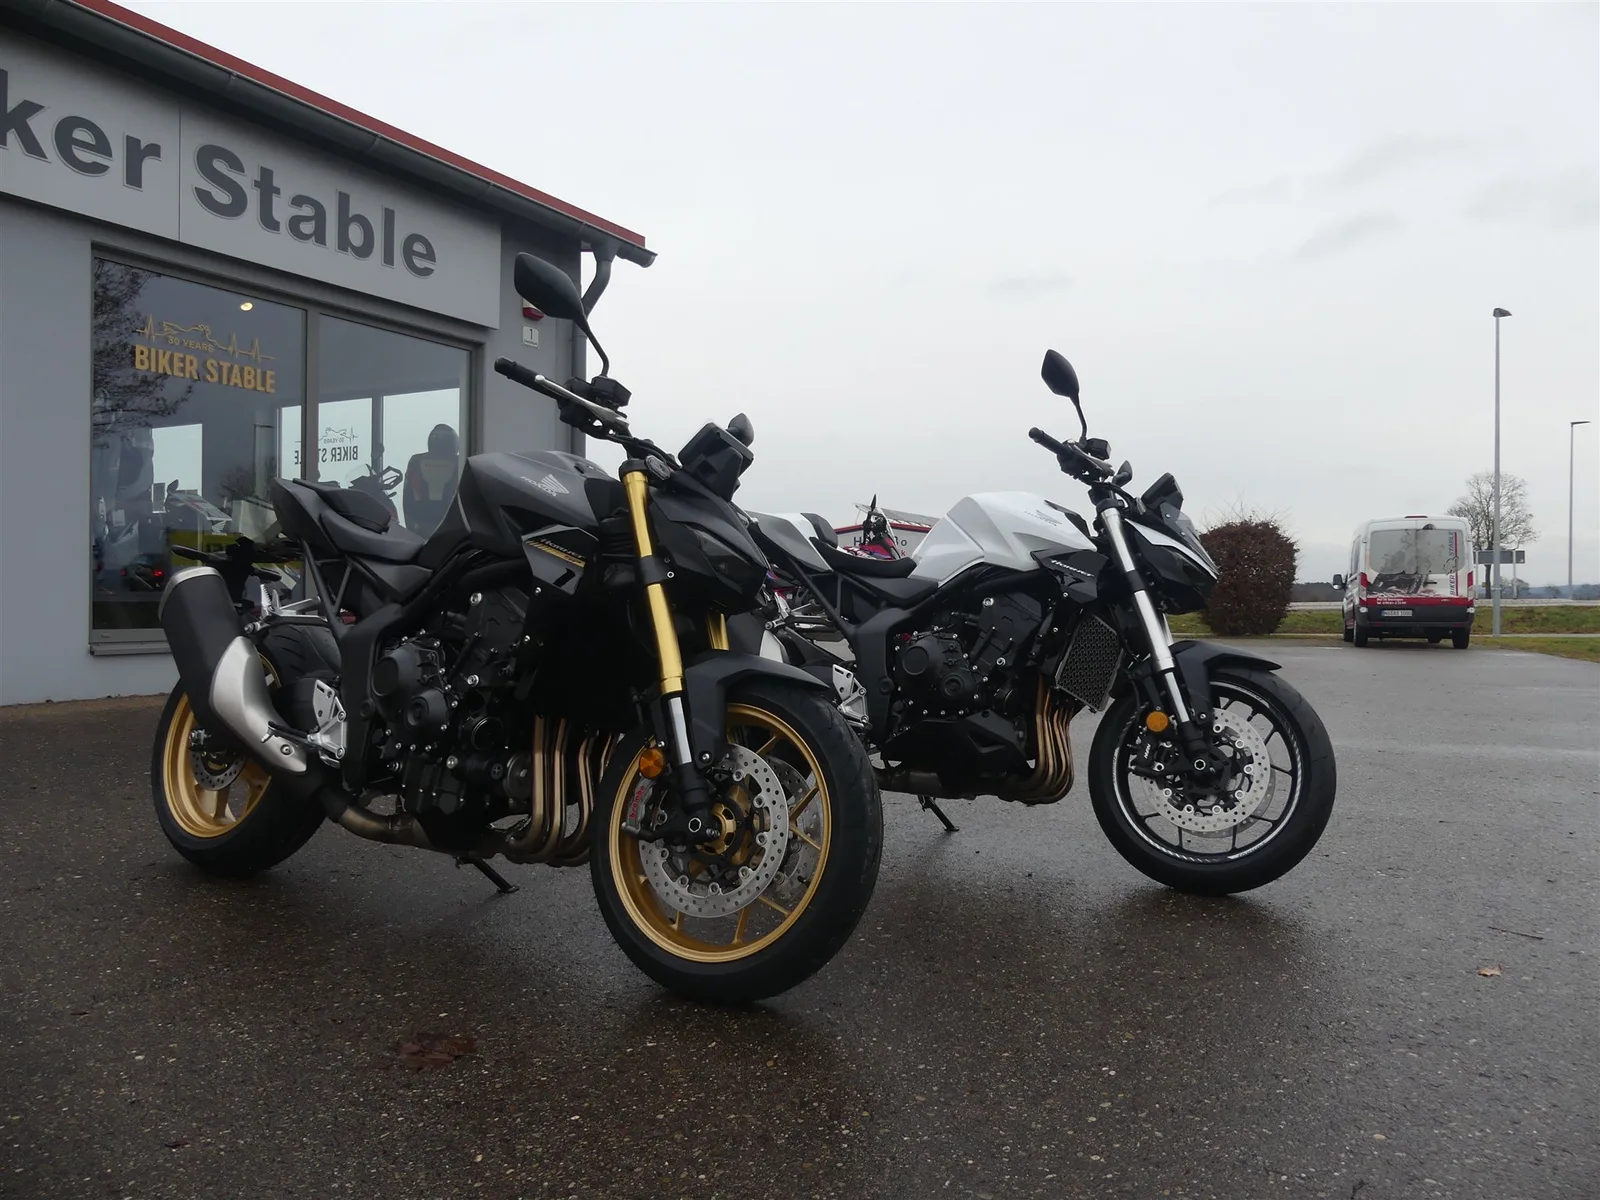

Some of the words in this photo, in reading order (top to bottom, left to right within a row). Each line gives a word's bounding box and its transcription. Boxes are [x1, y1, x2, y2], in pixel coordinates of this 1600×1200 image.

[192, 144, 437, 278] Stable
[182, 338, 214, 352] YEARS
[134, 344, 199, 380] BIKER
[205, 358, 276, 394] STABLE
[628, 785, 646, 820] brembo
